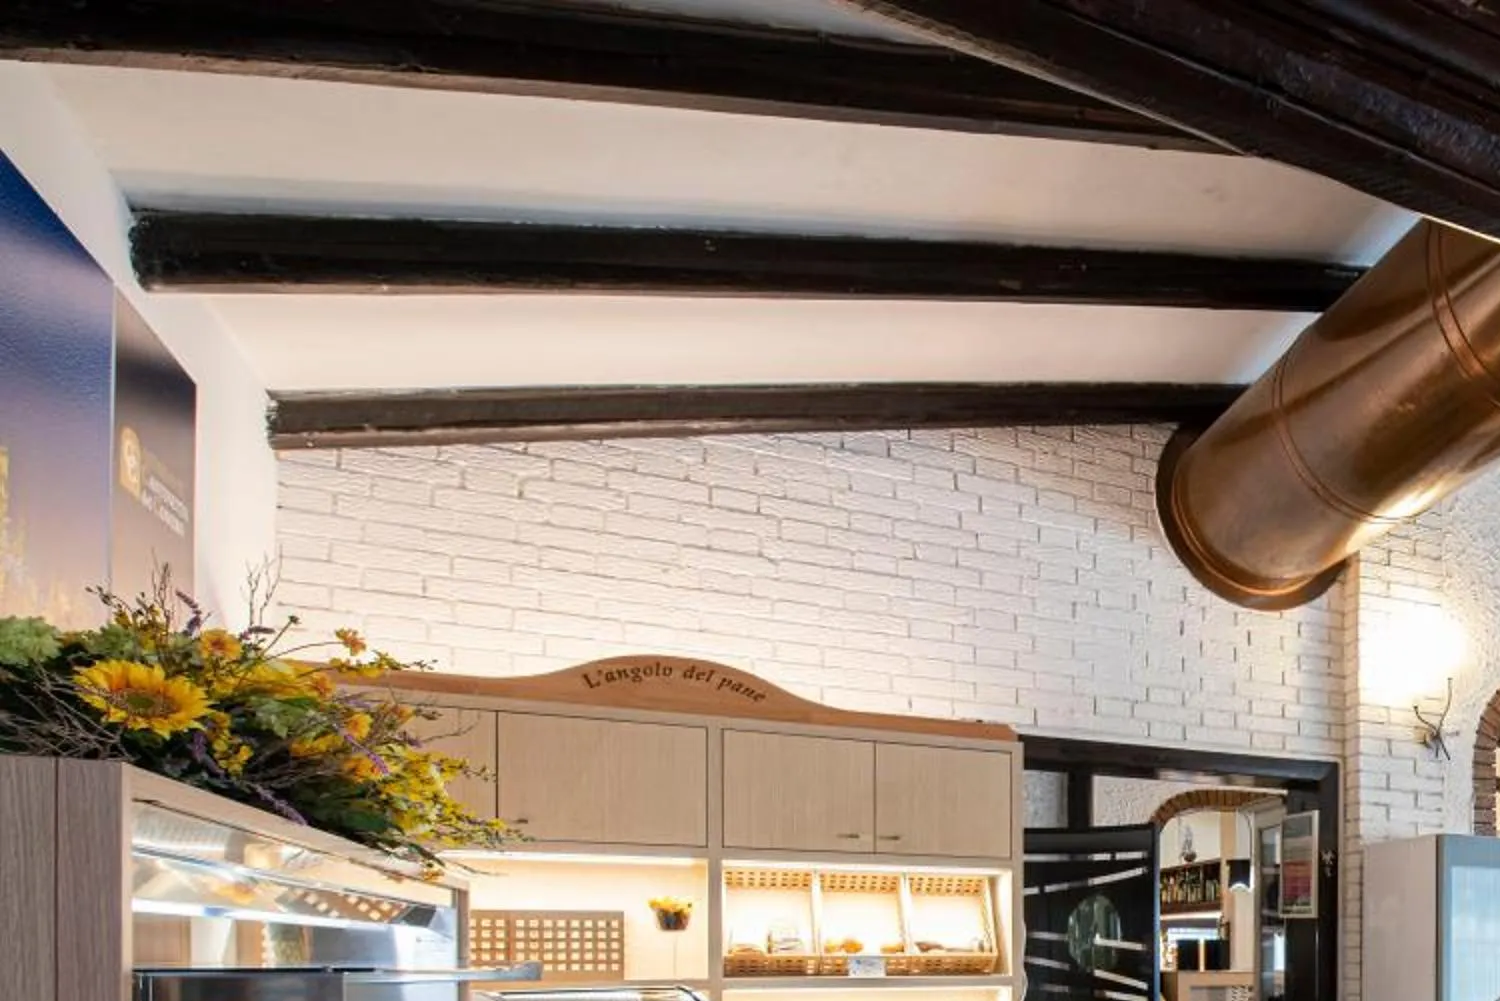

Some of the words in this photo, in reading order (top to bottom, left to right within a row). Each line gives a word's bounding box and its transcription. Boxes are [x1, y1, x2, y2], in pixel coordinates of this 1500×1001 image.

[582, 661, 673, 690] L'angolo
[683, 664, 715, 683] del
[716, 677, 767, 702] pane
